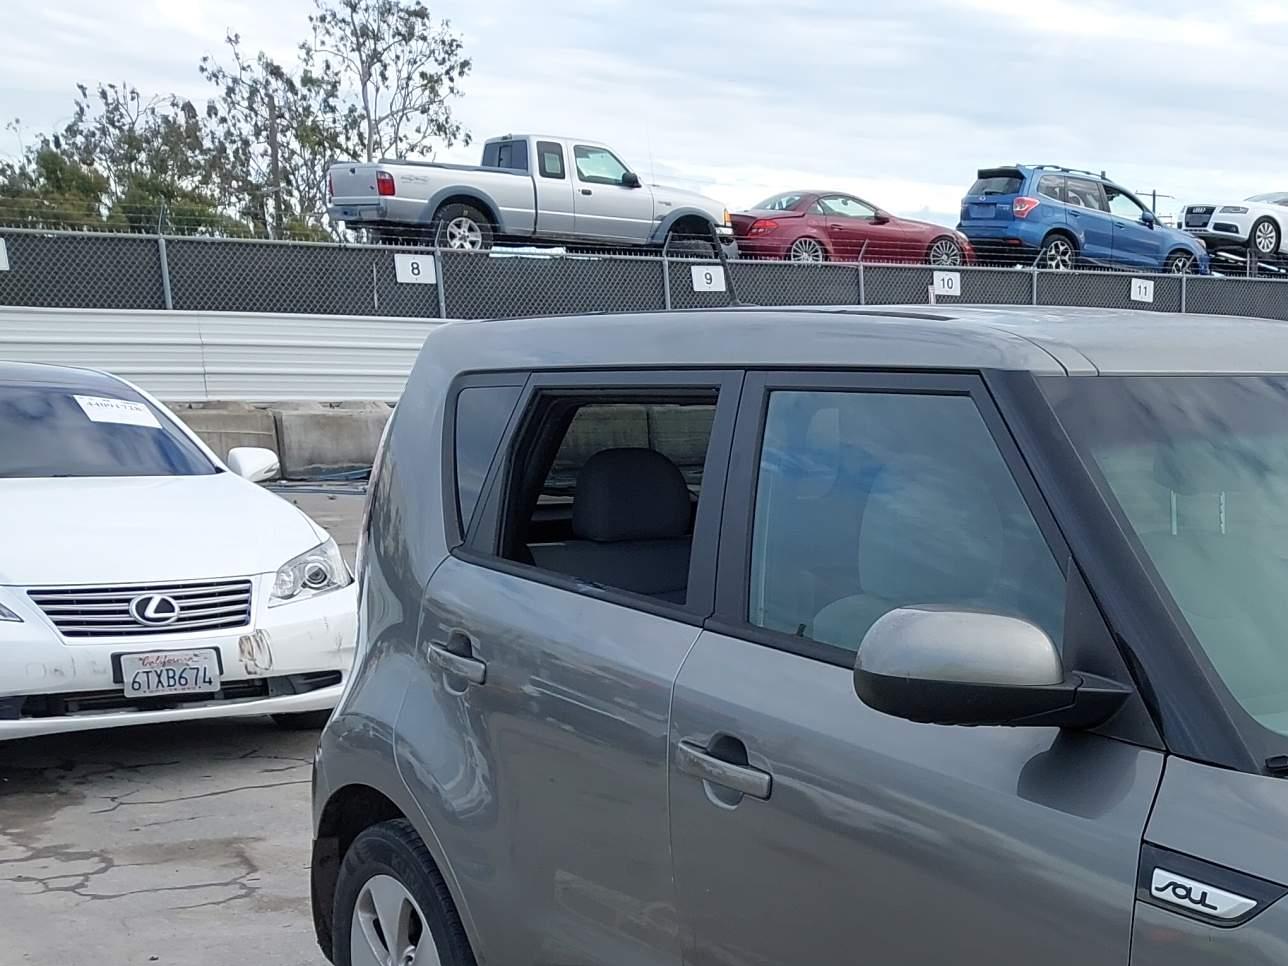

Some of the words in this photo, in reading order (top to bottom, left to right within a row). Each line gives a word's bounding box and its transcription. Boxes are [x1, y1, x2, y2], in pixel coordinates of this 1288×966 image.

[410, 261, 421, 277] 8
[704, 272, 713, 285] 9
[940, 277, 954, 290] 10
[1137, 284, 1148, 297] 11
[131, 666, 213, 691] 6TXB674
